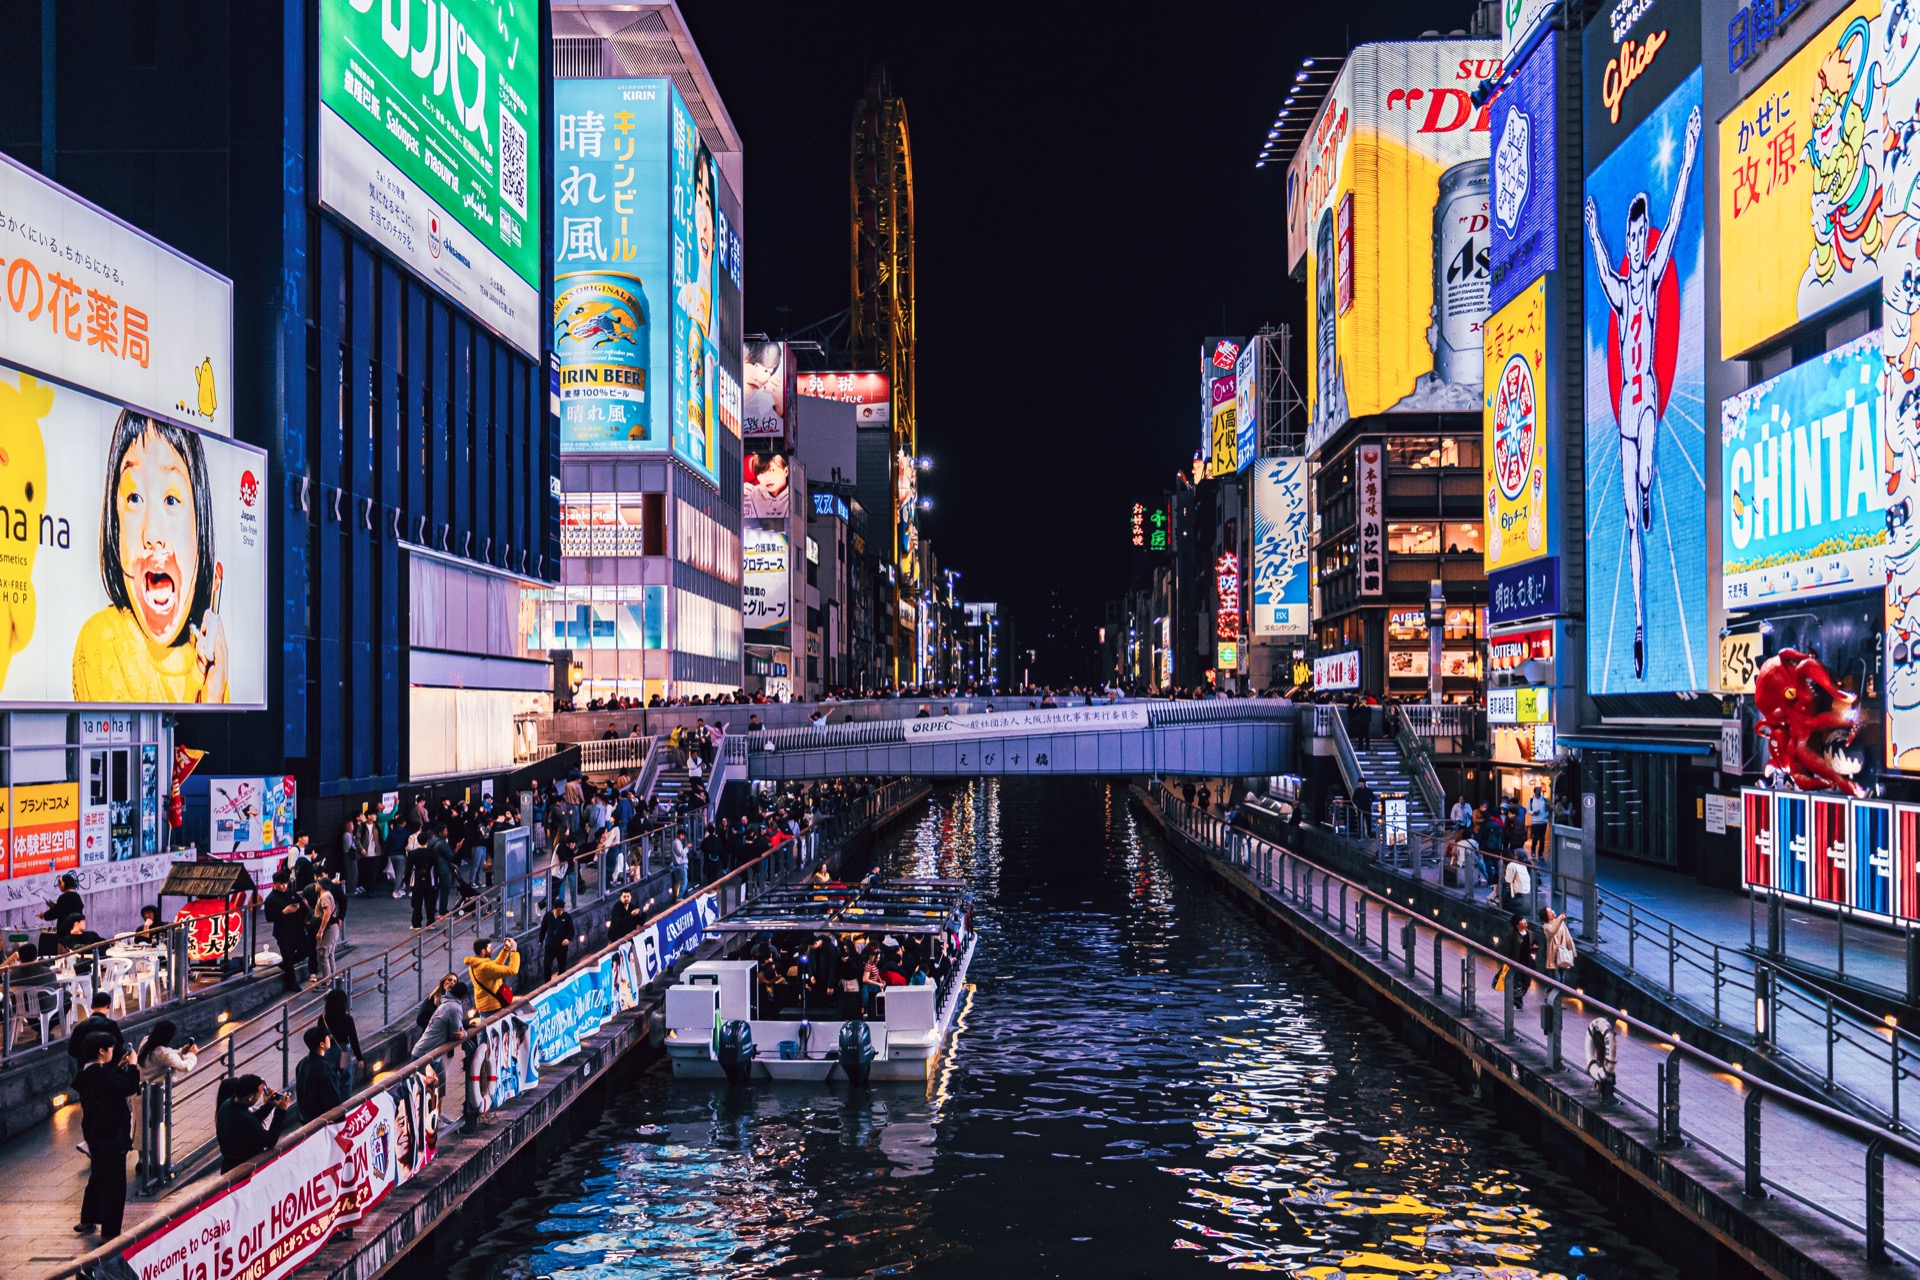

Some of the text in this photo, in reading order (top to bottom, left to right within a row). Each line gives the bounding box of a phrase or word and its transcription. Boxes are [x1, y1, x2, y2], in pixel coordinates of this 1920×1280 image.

[623, 90, 656, 101] KIRIN
[1737, 91, 1790, 154] かぜに
[1732, 120, 1797, 219] 改源
[557, 110, 608, 262] 晴れ風
[612, 110, 637, 262] キリンビール
[575, 284, 626, 300] ORIGINAL
[0, 256, 150, 370] の花薬局
[1630, 305, 1643, 405] グリコ
[560, 368, 641, 386] IRIN BEER
[809, 375, 855, 392] 免税
[564, 388, 630, 398] 麦芽100%ビール
[566, 404, 627, 424] 晴れ風
[1214, 412, 1225, 473] バイト
[1225, 408, 1236, 470] 高収入
[39, 512, 70, 549] na
[240, 523, 258, 536] Tax-free
[1363, 468, 1380, 591] 本場の味 かに道楽
[243, 535, 255, 547] Shop
[0, 554, 27, 567] smetics
[1276, 612, 1288, 620] BX
[1492, 641, 1523, 658] LOTTERIA
[1023, 709, 1138, 725] 大阪活性化事業実行委員会
[959, 753, 1049, 766] えびす橋
[20, 796, 70, 813] ブランドコスメ
[13, 829, 76, 858] 体験型空間
[140, 1219, 231, 1280] Welcome to Osaka
[214, 1242, 233, 1280] is
[238, 1220, 265, 1264] our
